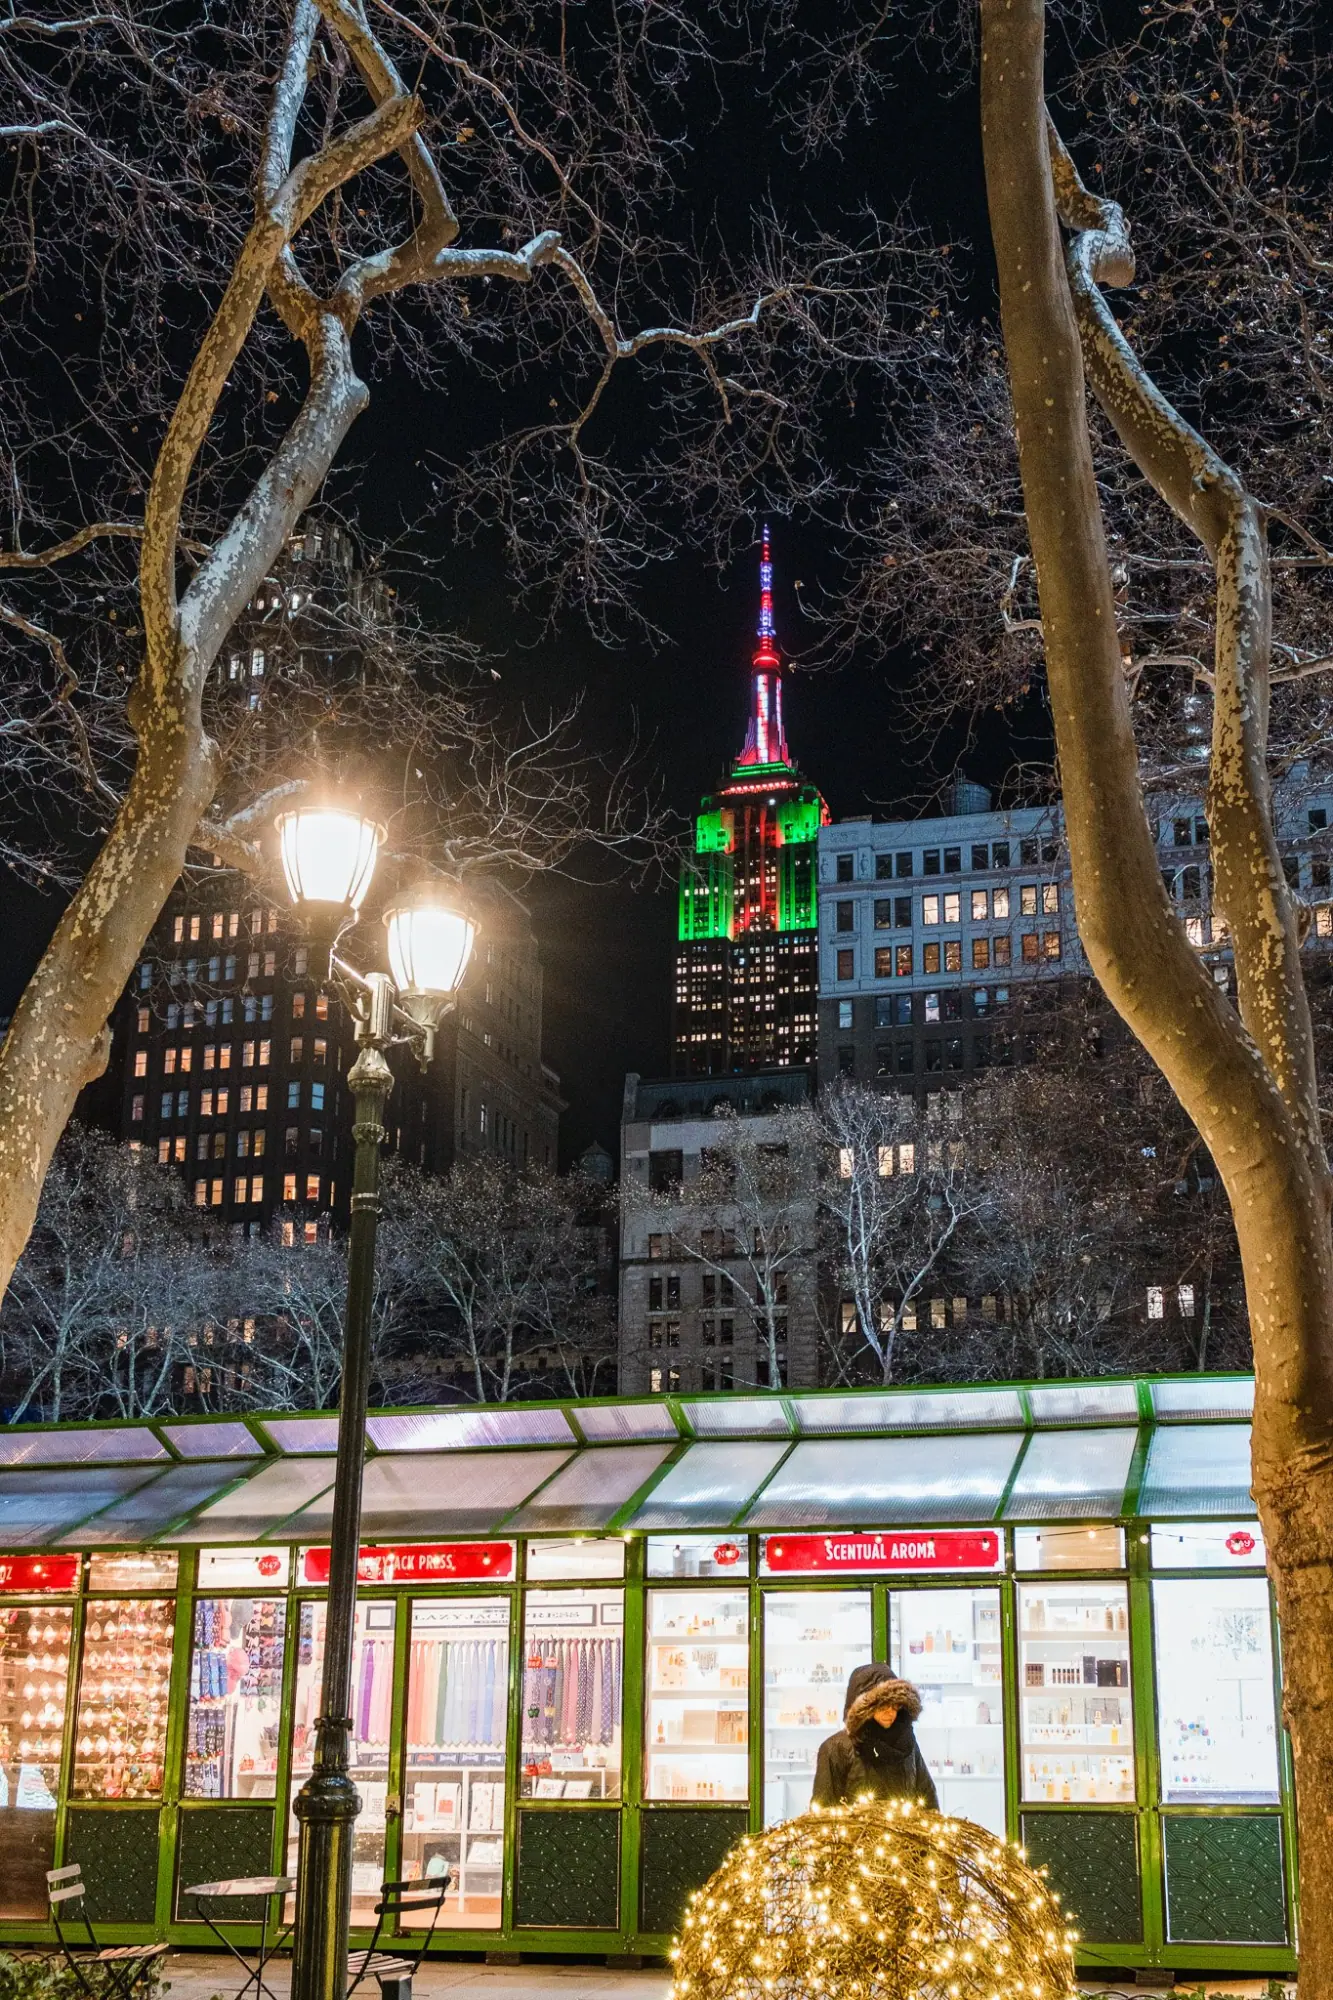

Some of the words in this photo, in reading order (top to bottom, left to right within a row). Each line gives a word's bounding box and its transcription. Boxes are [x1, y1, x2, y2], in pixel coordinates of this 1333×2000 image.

[717, 1549, 737, 1559] N8
[825, 1543, 887, 1561] SCENTUAL
[890, 1542, 936, 1559] AROMA
[359, 1555, 415, 1572] ZYACK
